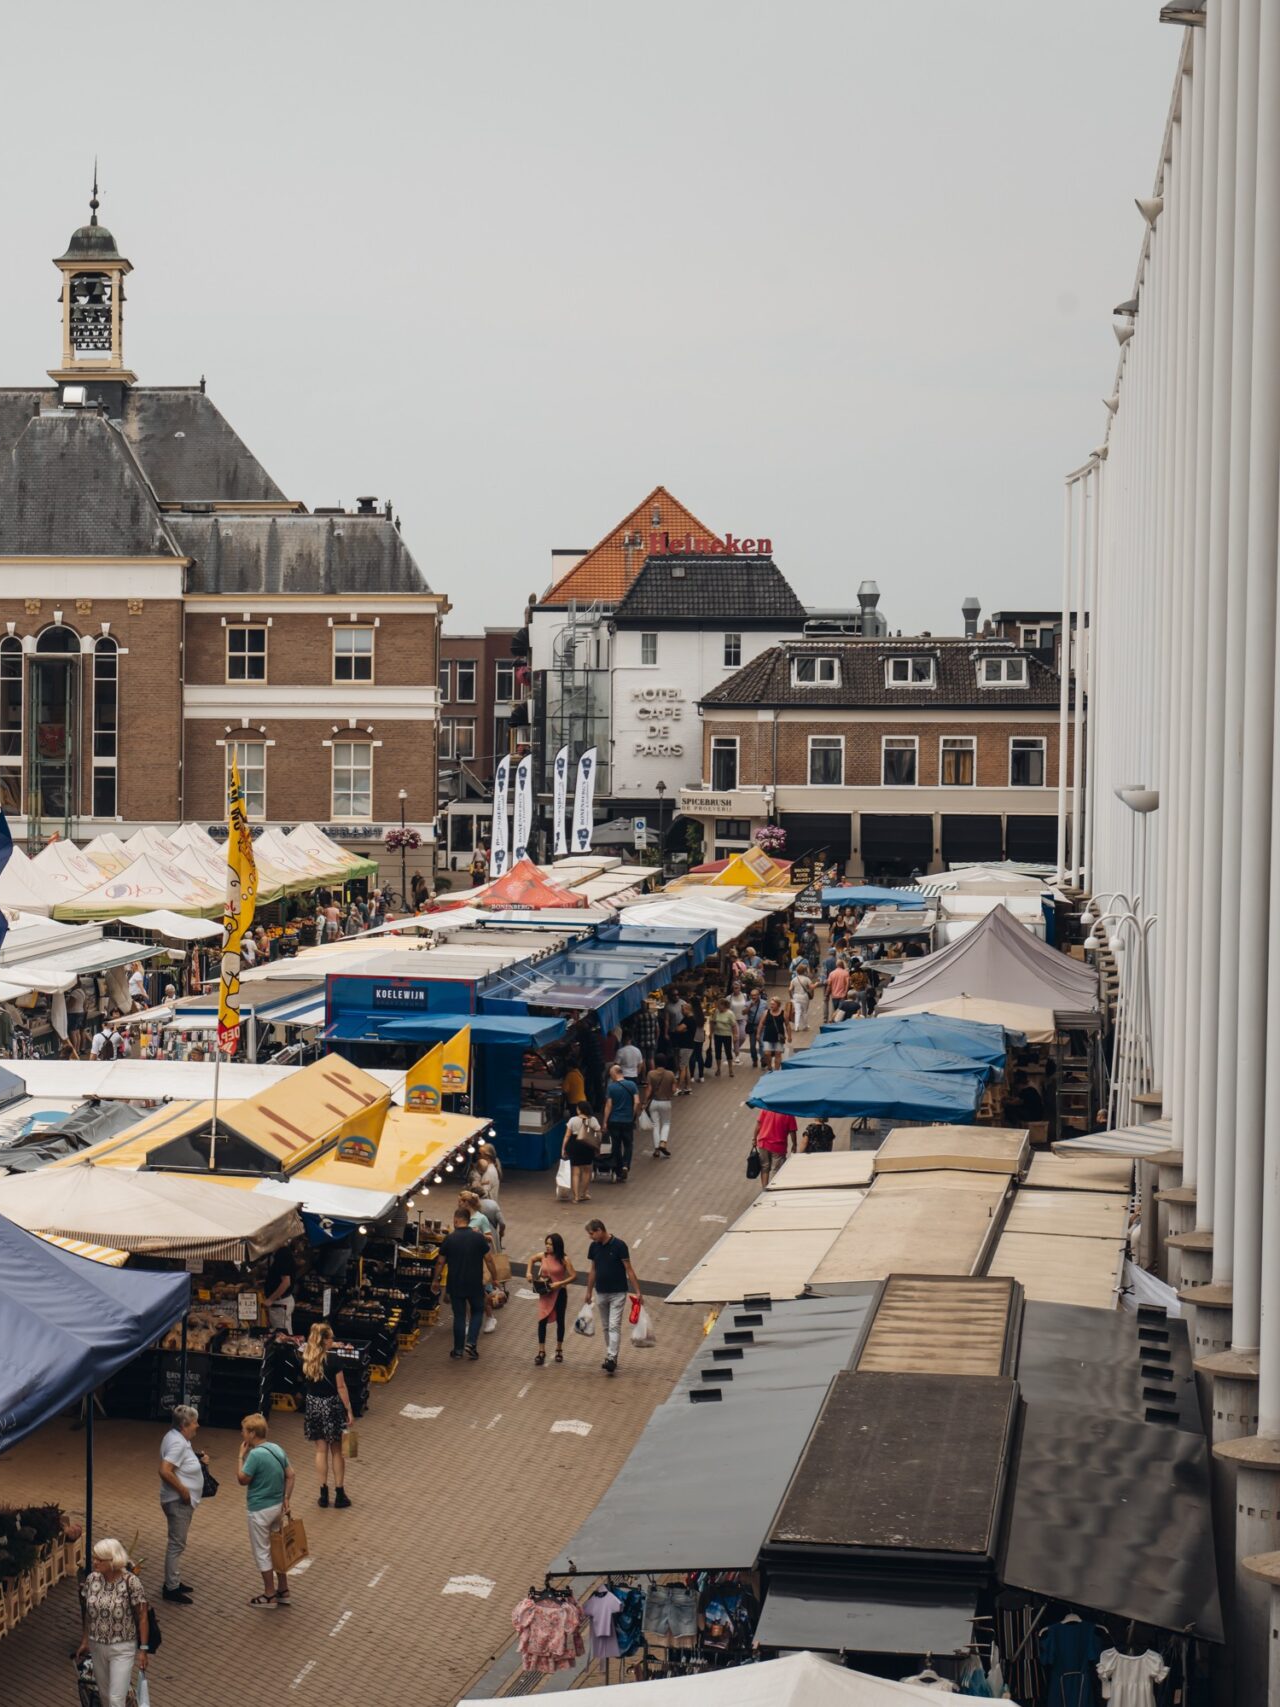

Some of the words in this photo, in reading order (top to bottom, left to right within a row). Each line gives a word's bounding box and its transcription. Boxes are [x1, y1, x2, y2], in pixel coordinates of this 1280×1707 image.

[649, 532, 773, 555] Heineken
[630, 687, 685, 702] HOTEL
[636, 706, 682, 720] CAFE
[647, 724, 670, 739] DE
[632, 742, 684, 757] PARIS
[681, 798, 732, 806] SPICEBRUSH
[376, 989, 425, 1000] KOELEWIJN
